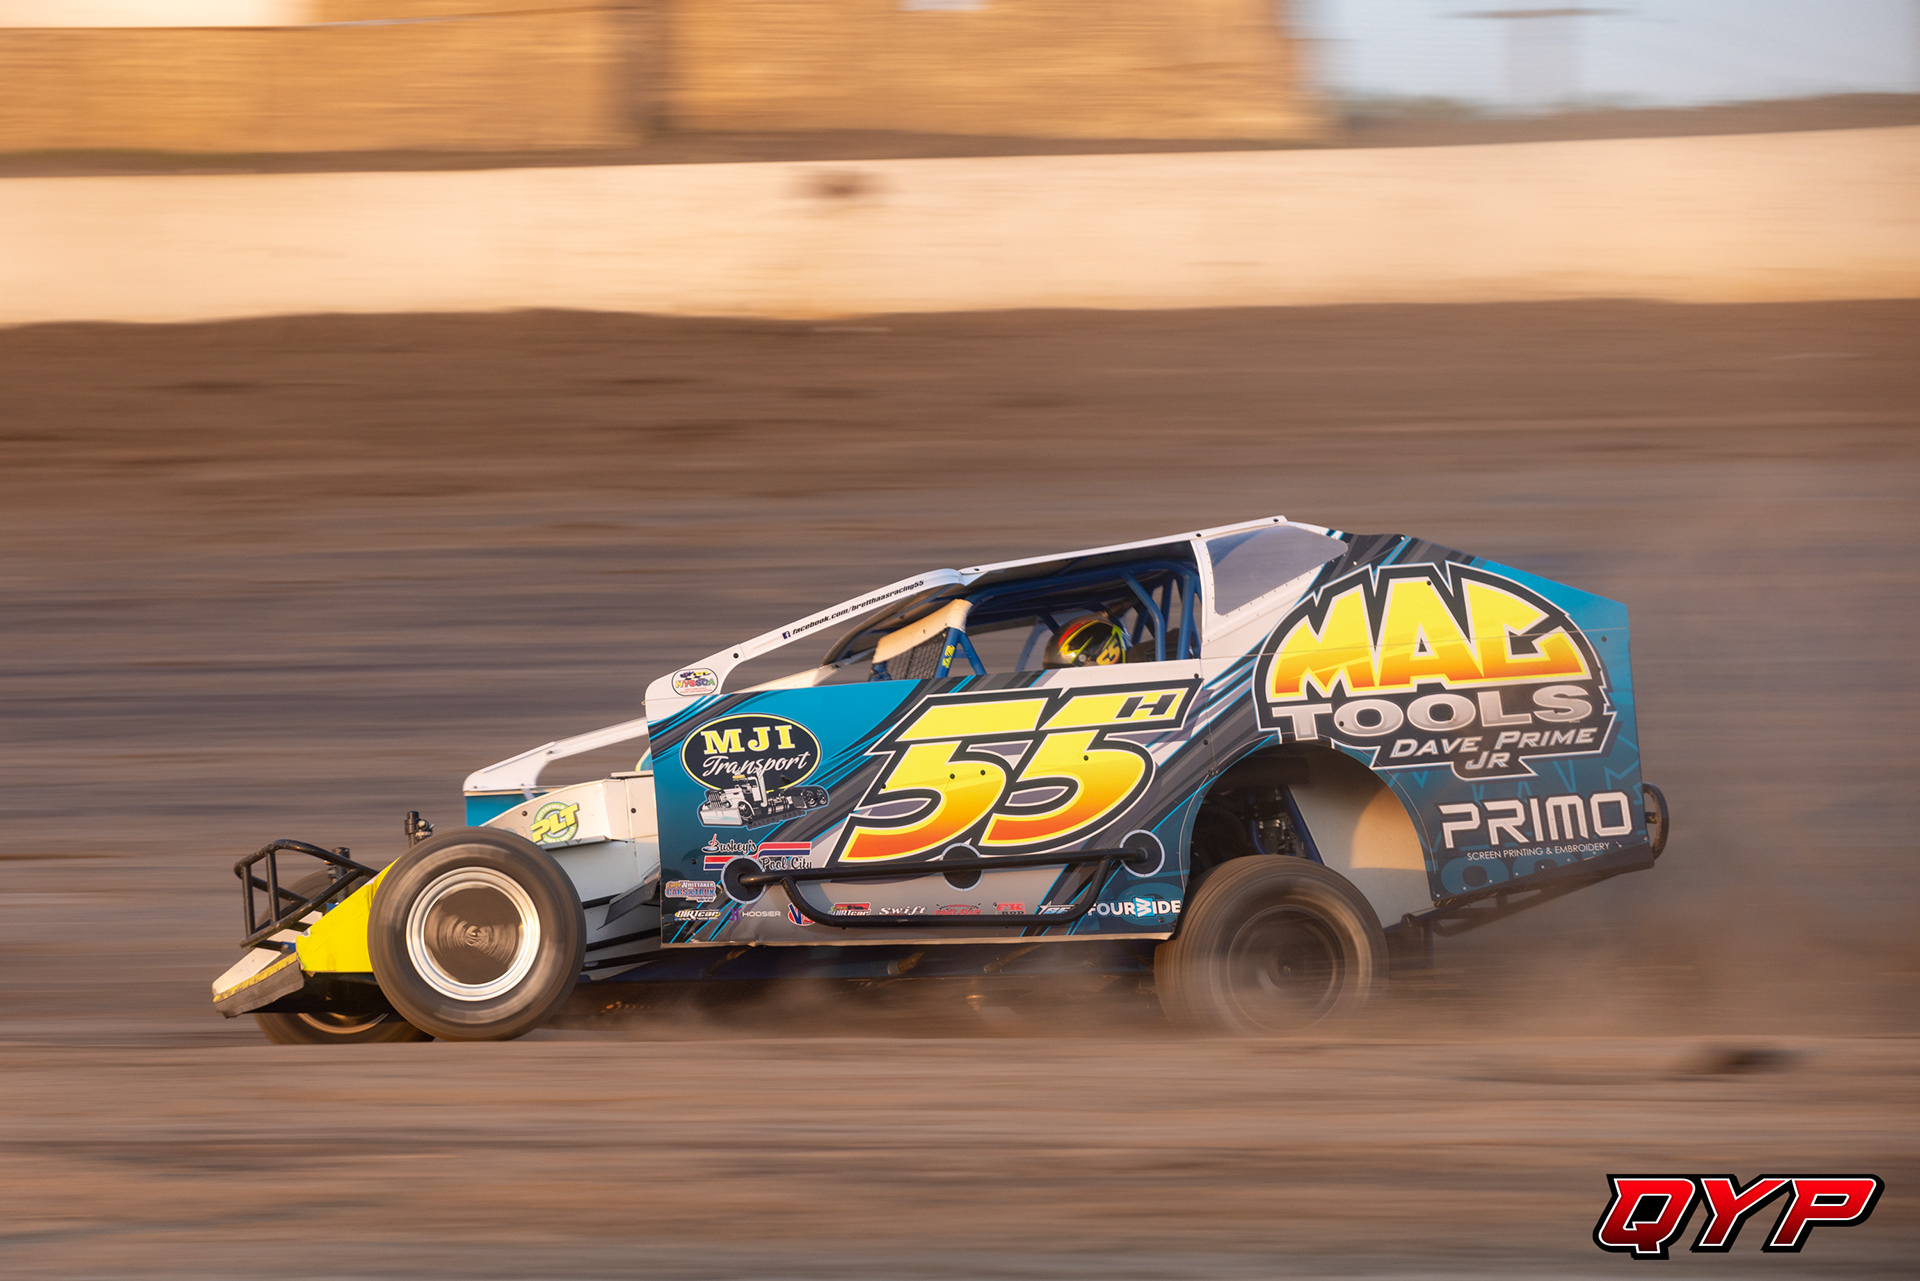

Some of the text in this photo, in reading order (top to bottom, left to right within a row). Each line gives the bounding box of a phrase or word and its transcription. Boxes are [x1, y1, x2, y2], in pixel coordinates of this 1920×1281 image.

[792, 580, 925, 635] facebook.com/bretthaasracing55
[1266, 577, 1593, 703] MAC
[1272, 685, 1593, 741] TOOLS
[701, 725, 796, 754] MJI
[1389, 727, 1598, 758] DAVE PRIME
[702, 751, 811, 777] Transport
[1465, 752, 1511, 770] JR
[838, 688, 1190, 862] 55
[530, 803, 580, 843] PLT
[1438, 792, 1633, 849] PRIMO
[709, 839, 758, 854] Bushey's
[1467, 842, 1610, 861] SCREEN PRINTING & EMBROIDERY
[760, 857, 813, 869] Pool City
[879, 905, 928, 915] Swift
[996, 903, 1025, 911] FK
[1088, 897, 1182, 917] FOURWIDE
